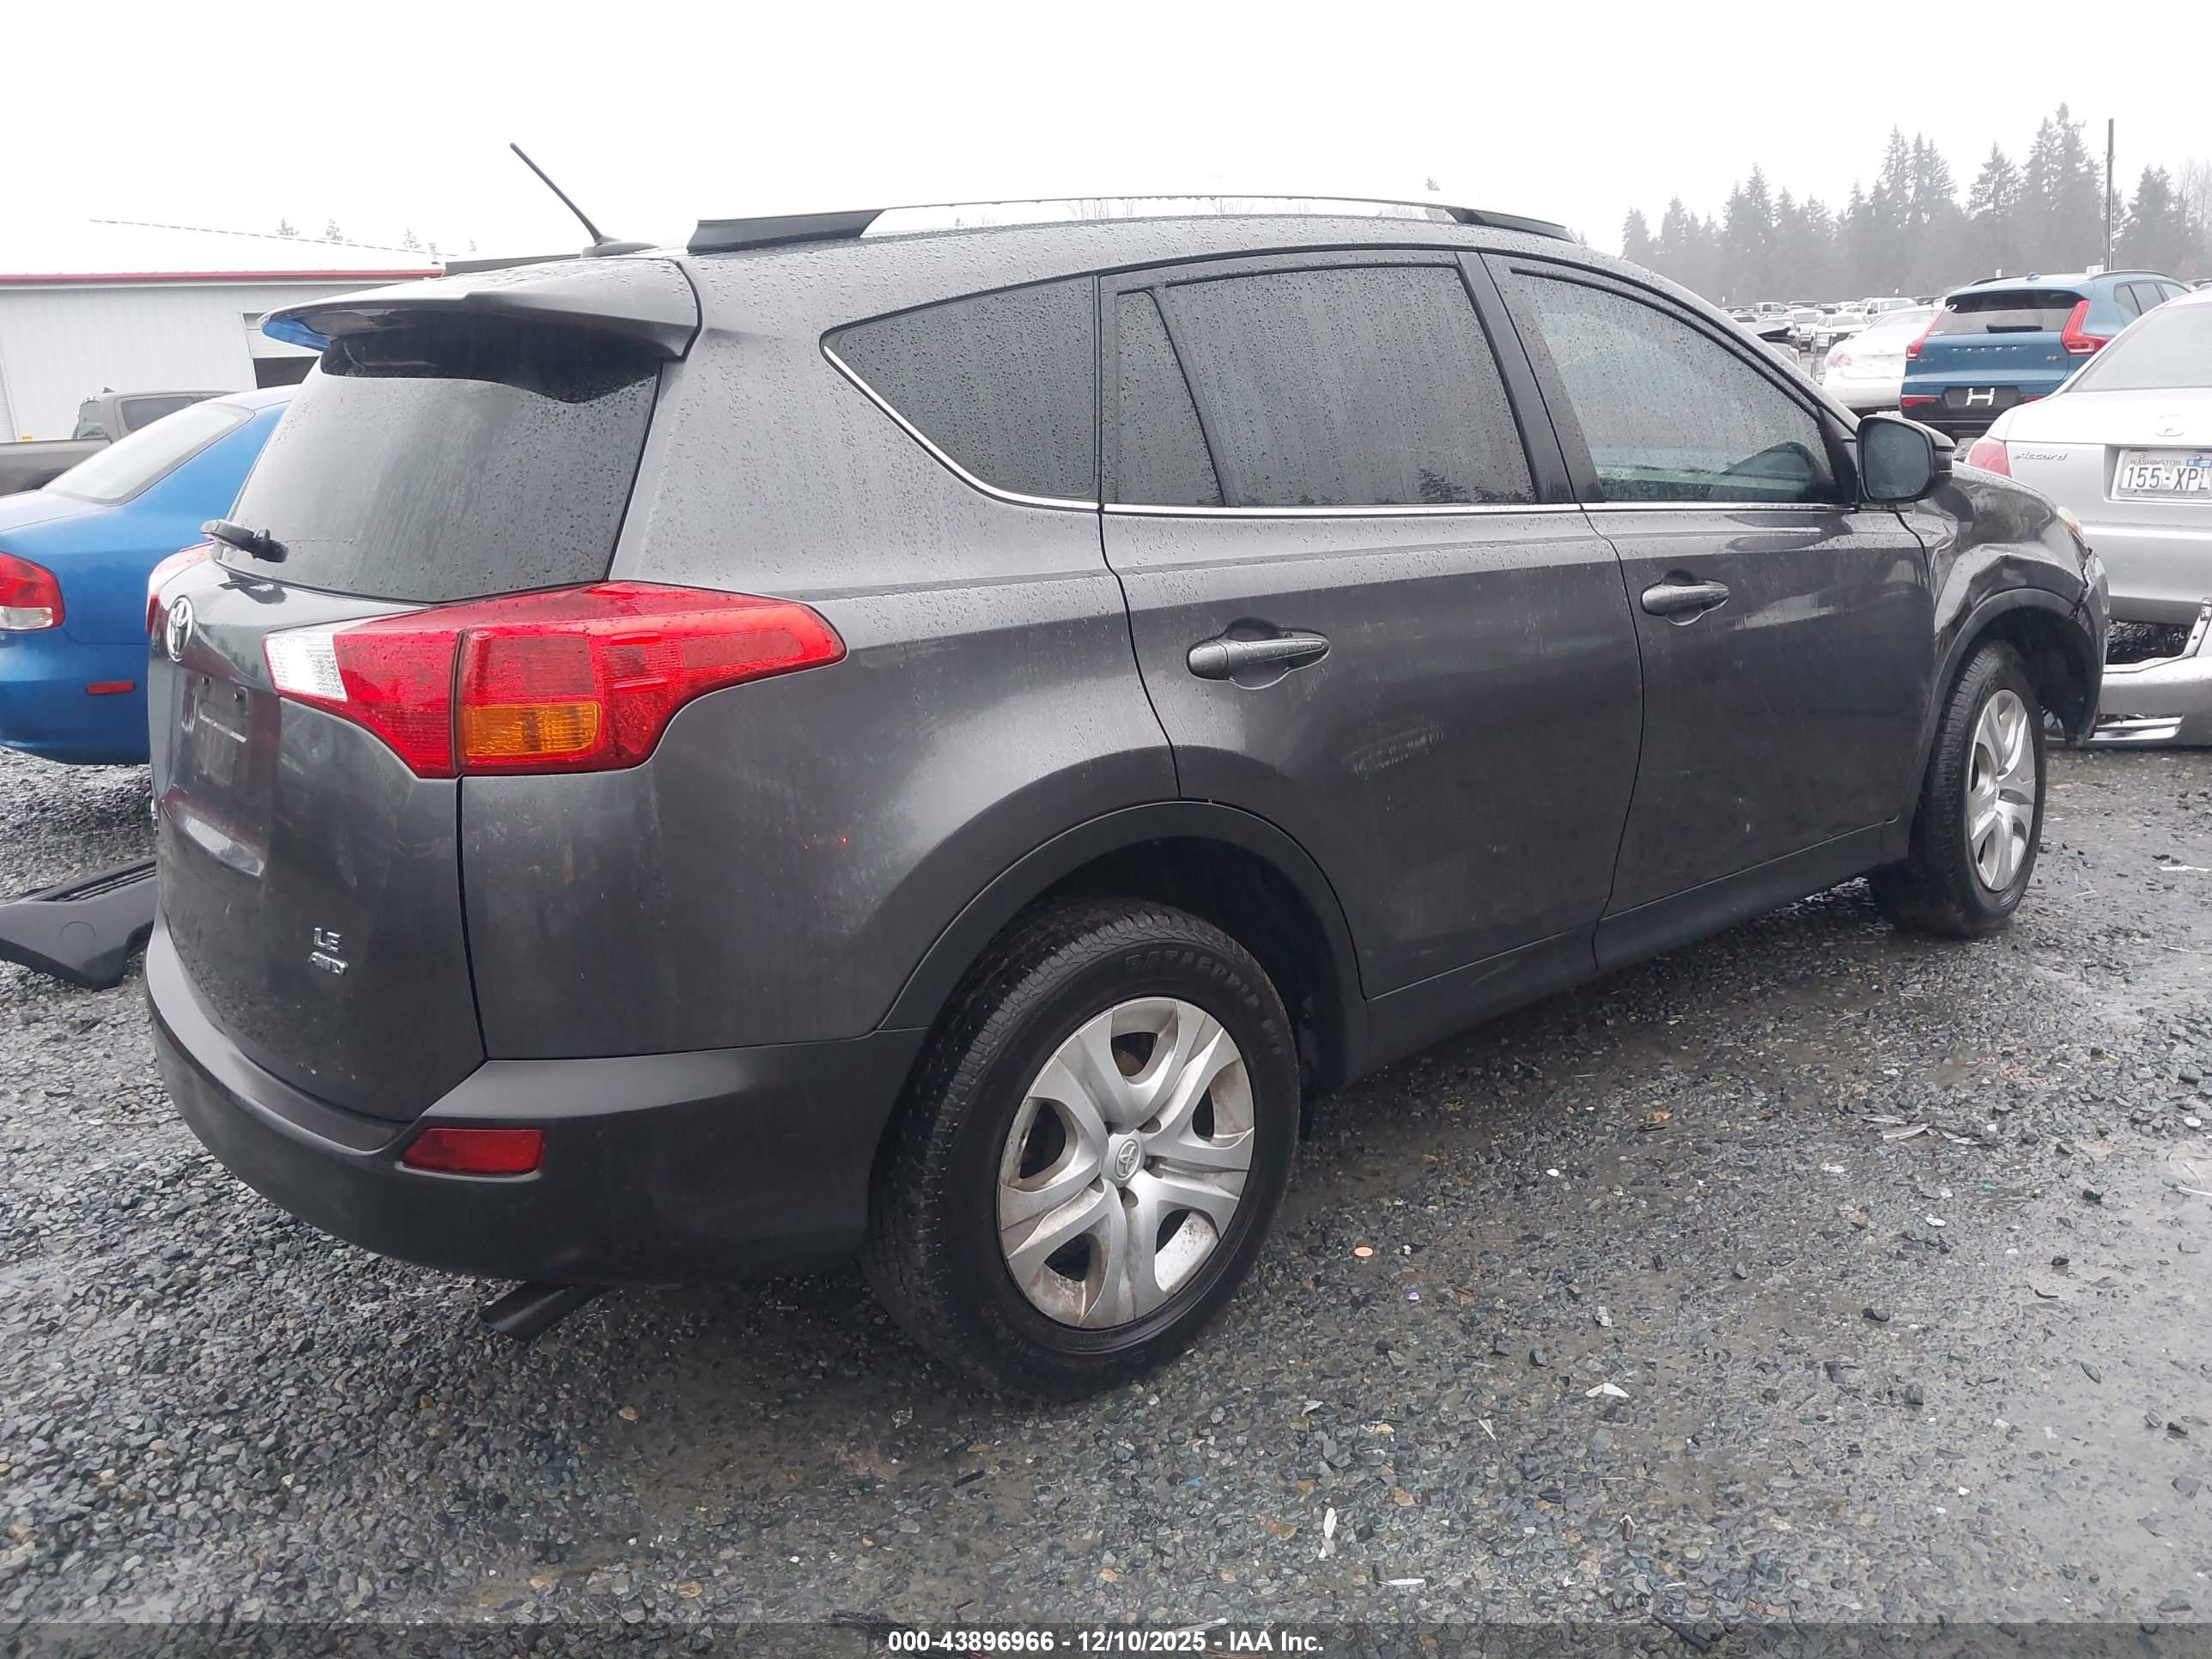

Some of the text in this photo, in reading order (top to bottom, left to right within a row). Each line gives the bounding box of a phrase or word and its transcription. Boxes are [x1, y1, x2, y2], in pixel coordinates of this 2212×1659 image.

[2014, 452, 2068, 461] Accord
[2129, 458, 2182, 467] WASHINGTON
[313, 927, 343, 953] LE
